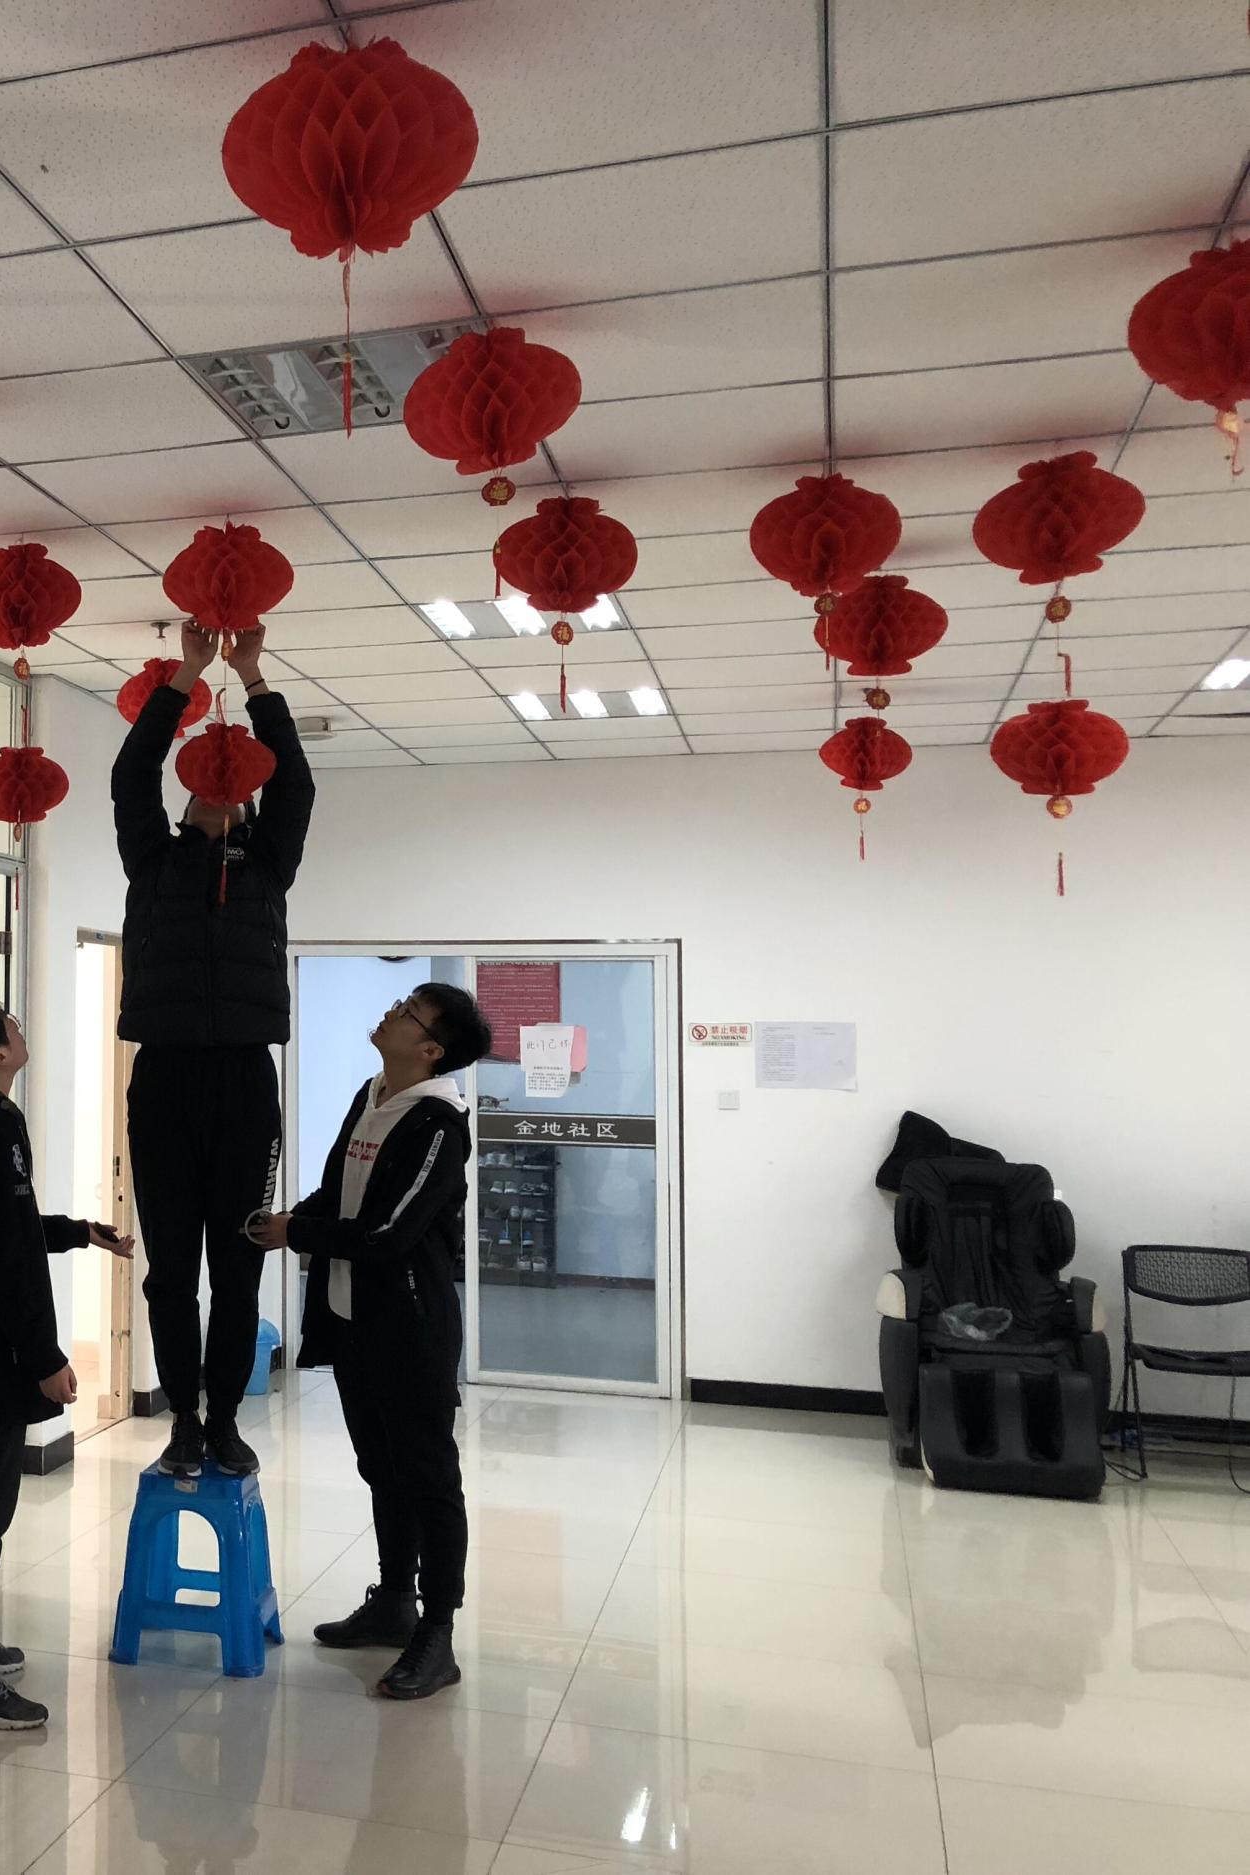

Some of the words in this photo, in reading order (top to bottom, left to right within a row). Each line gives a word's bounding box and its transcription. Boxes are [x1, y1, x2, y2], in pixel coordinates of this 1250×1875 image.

[711, 1025, 748, 1034] 禁止吸烟
[514, 1120, 619, 1139] 金地社区
